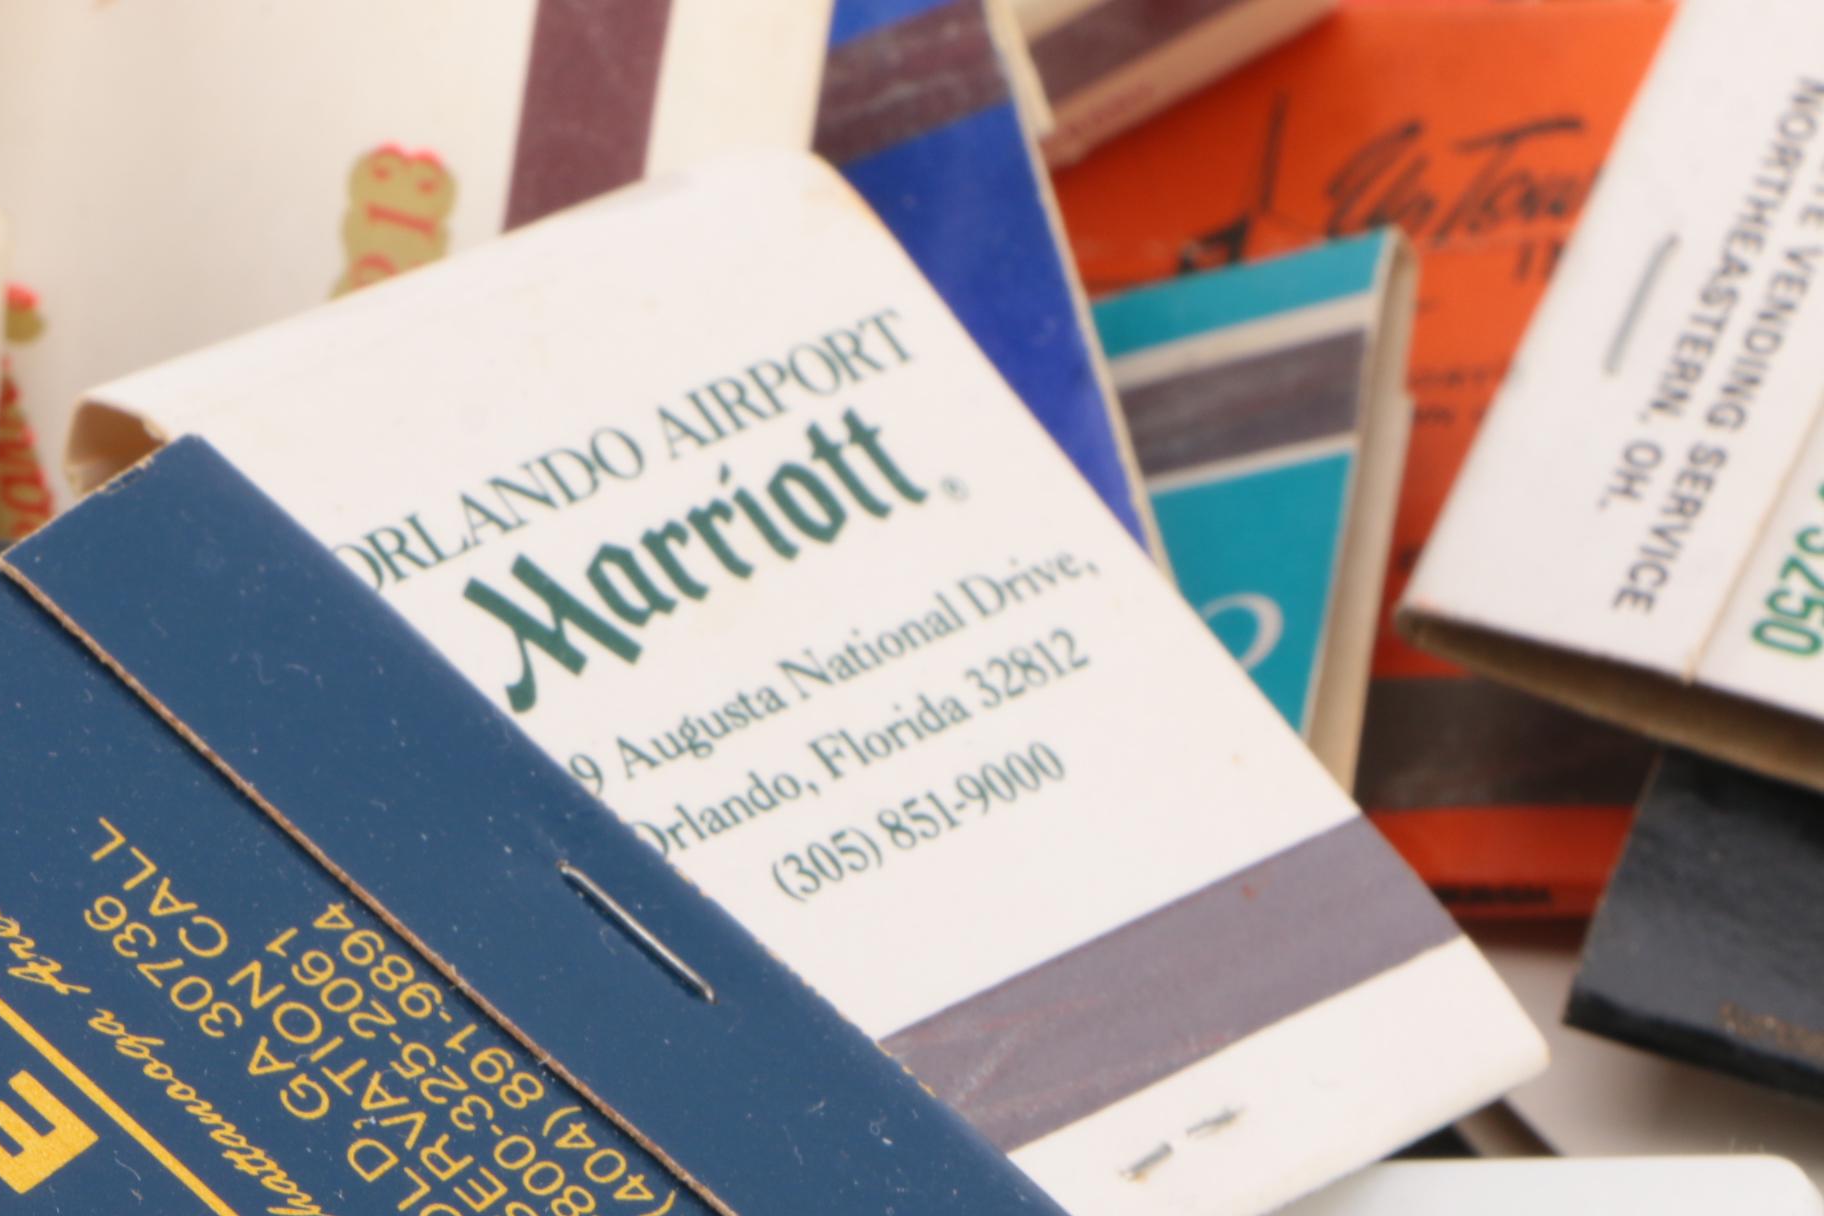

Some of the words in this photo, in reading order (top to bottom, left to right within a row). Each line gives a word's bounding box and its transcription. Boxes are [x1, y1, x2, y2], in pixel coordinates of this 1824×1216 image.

[657, 308, 914, 459] AIRPORT
[462, 407, 928, 715] Marriott
[1613, 441, 1727, 614] SERVICE
[614, 683, 789, 783] Augusta
[778, 592, 966, 700] National
[958, 550, 1101, 619] Drive,
[807, 689, 971, 781] Florida
[966, 628, 1090, 711] 32812
[91, 817, 228, 958] CALL
[771, 826, 885, 902] (305)
[876, 742, 1068, 852] 851-9000
[84, 896, 243, 1037] 30736
[312, 902, 544, 1109] 891-9894
[248, 1036, 330, 1119] GA
